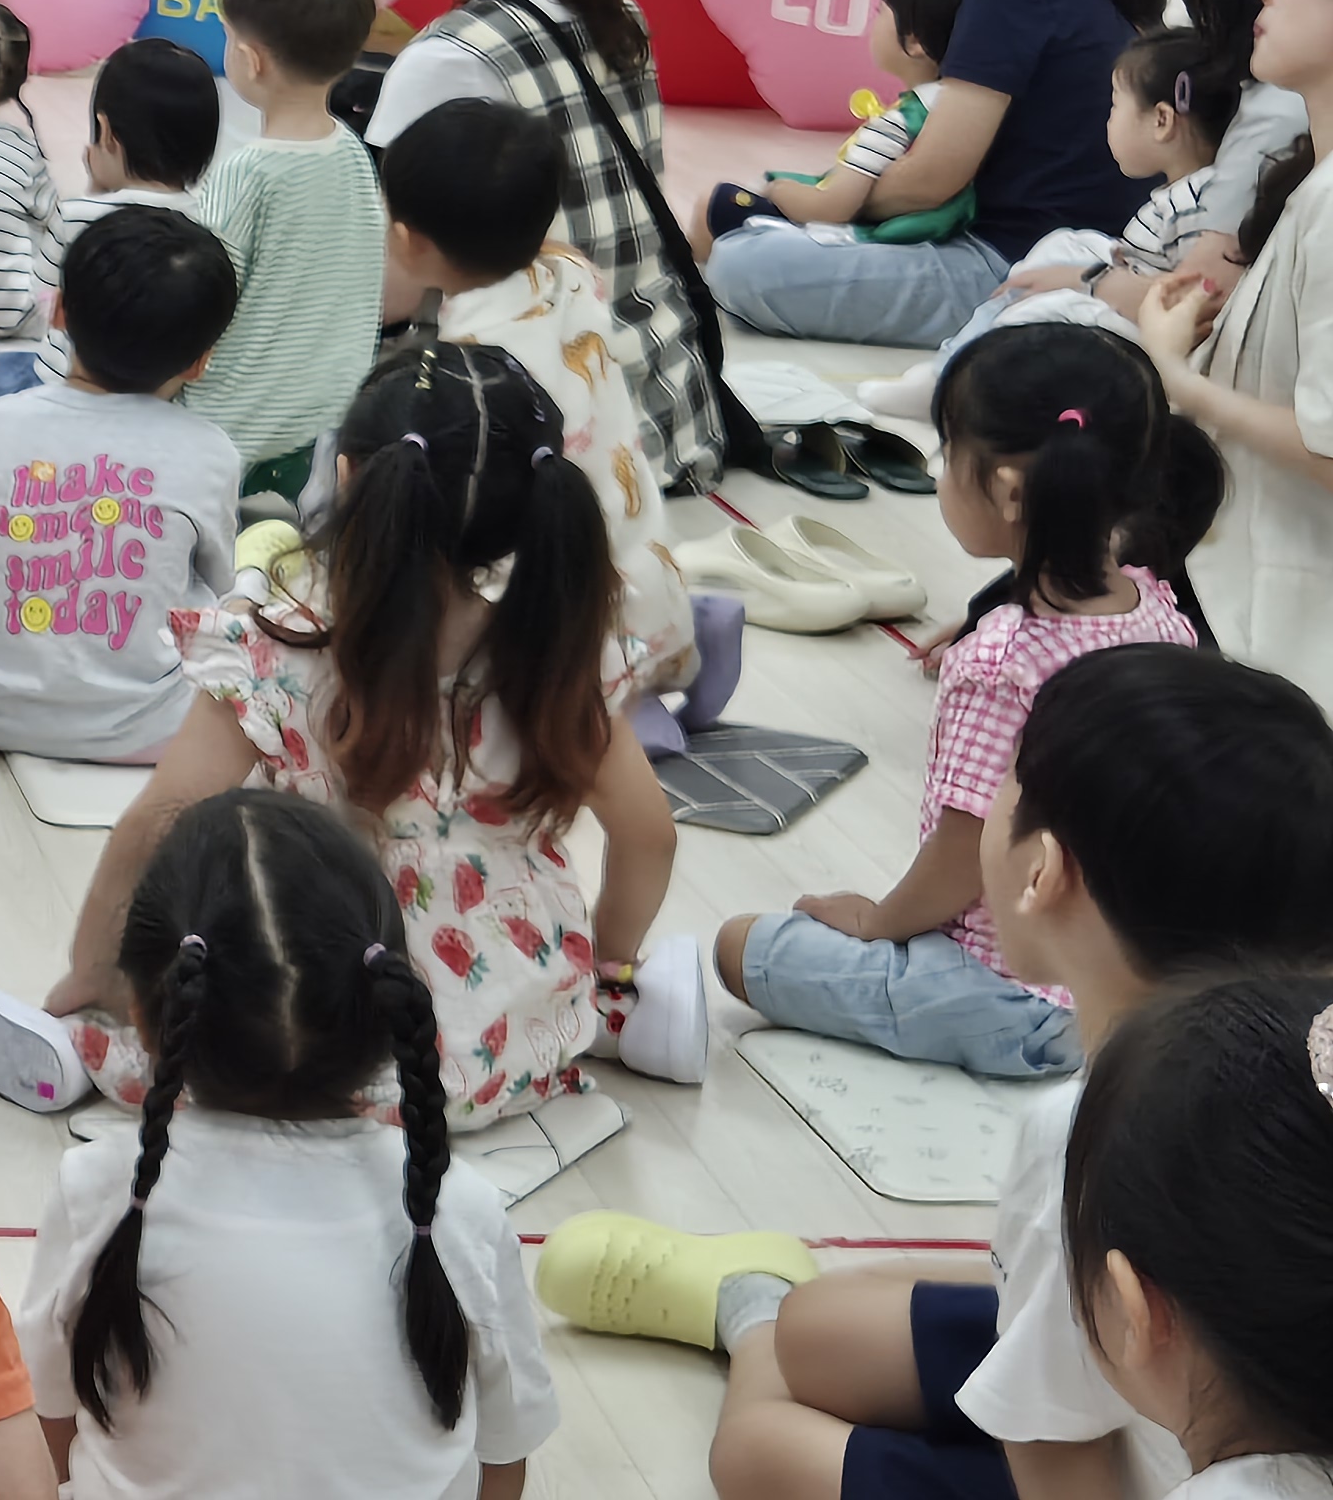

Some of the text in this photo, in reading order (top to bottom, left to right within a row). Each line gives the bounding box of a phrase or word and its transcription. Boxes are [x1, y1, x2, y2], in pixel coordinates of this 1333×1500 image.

[11, 454, 155, 507] make
[5, 525, 146, 592] smile
[4, 579, 143, 652] today
